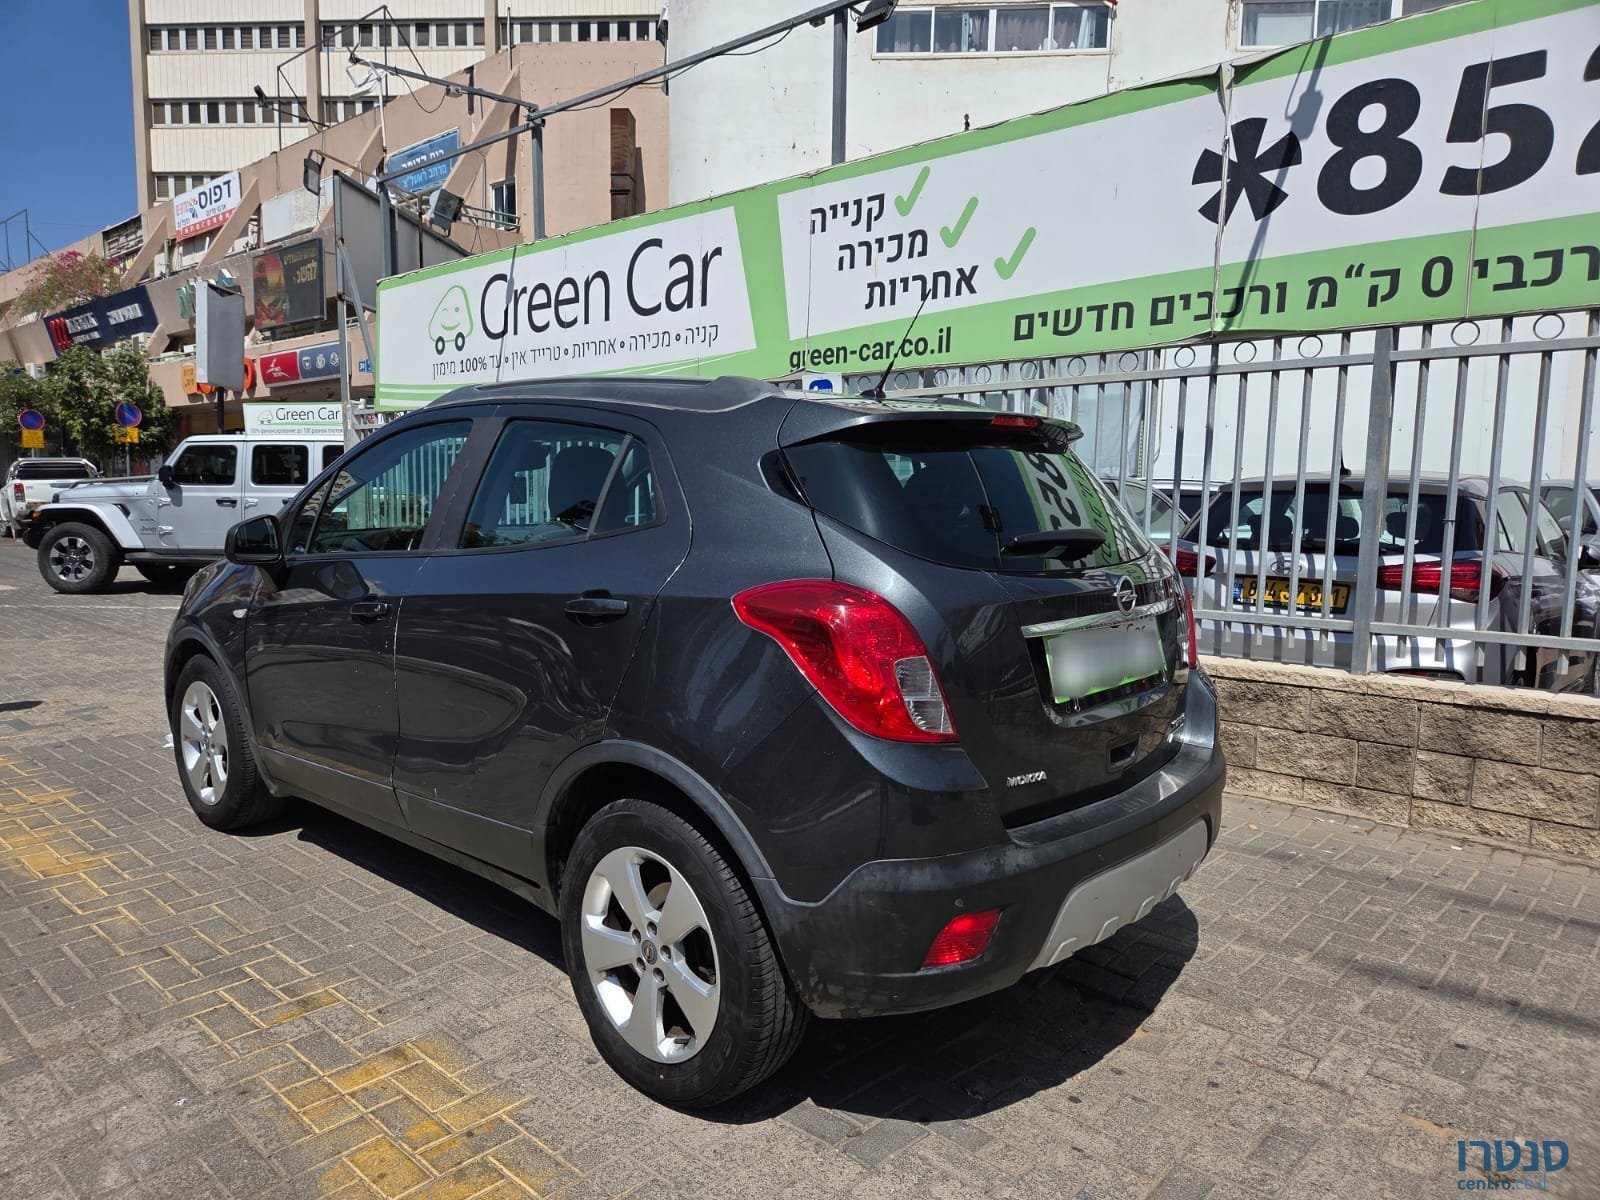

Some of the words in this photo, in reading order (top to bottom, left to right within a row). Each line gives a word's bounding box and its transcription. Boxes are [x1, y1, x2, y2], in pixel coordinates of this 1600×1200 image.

[1192, 42, 1600, 226] 85
[198, 179, 231, 209] דפוס
[810, 192, 885, 235] קנייה
[838, 229, 928, 271] מכירה
[480, 270, 610, 340] Green
[627, 238, 723, 317] Car
[865, 265, 979, 310] אחריות
[1421, 255, 1453, 298] 0
[1150, 281, 1288, 327] ורכבים
[1014, 301, 1134, 341] חדשים
[572, 338, 617, 359] אחריות
[629, 331, 671, 351] מכירה
[685, 324, 719, 347] קניה
[489, 355, 501, 369] עד
[511, 350, 527, 370] אין
[530, 346, 561, 363] טרייד
[789, 326, 952, 372] green-car.co.il
[432, 360, 456, 381] מימון
[459, 356, 487, 373] 100%
[276, 407, 315, 421] Green
[318, 407, 341, 420] Car
[1006, 770, 1047, 788] MOKKA
